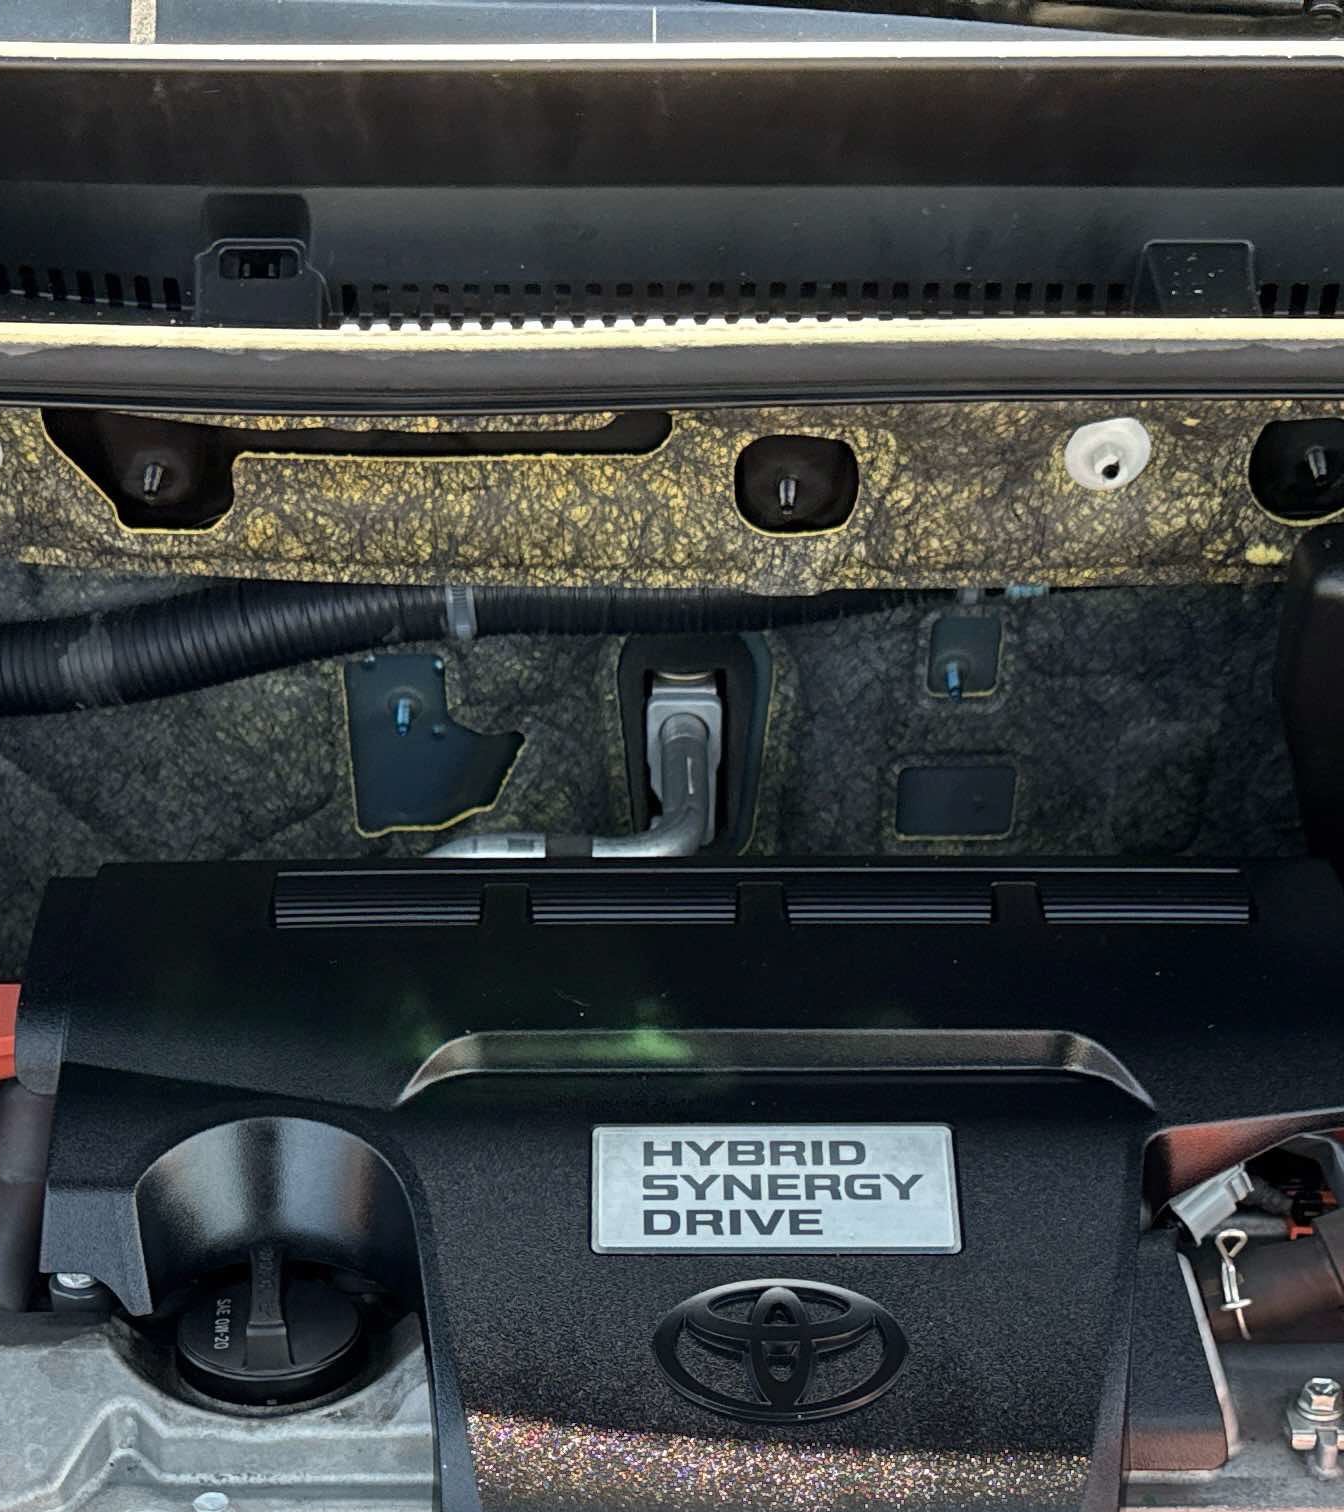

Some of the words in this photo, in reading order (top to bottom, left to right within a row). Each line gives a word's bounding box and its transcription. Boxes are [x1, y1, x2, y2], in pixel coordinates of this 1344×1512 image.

[643, 1140, 866, 1167] HYBRID
[642, 1174, 924, 1201] SYNERGY
[643, 1209, 824, 1236] DRIVE
[216, 1298, 232, 1316] SAE
